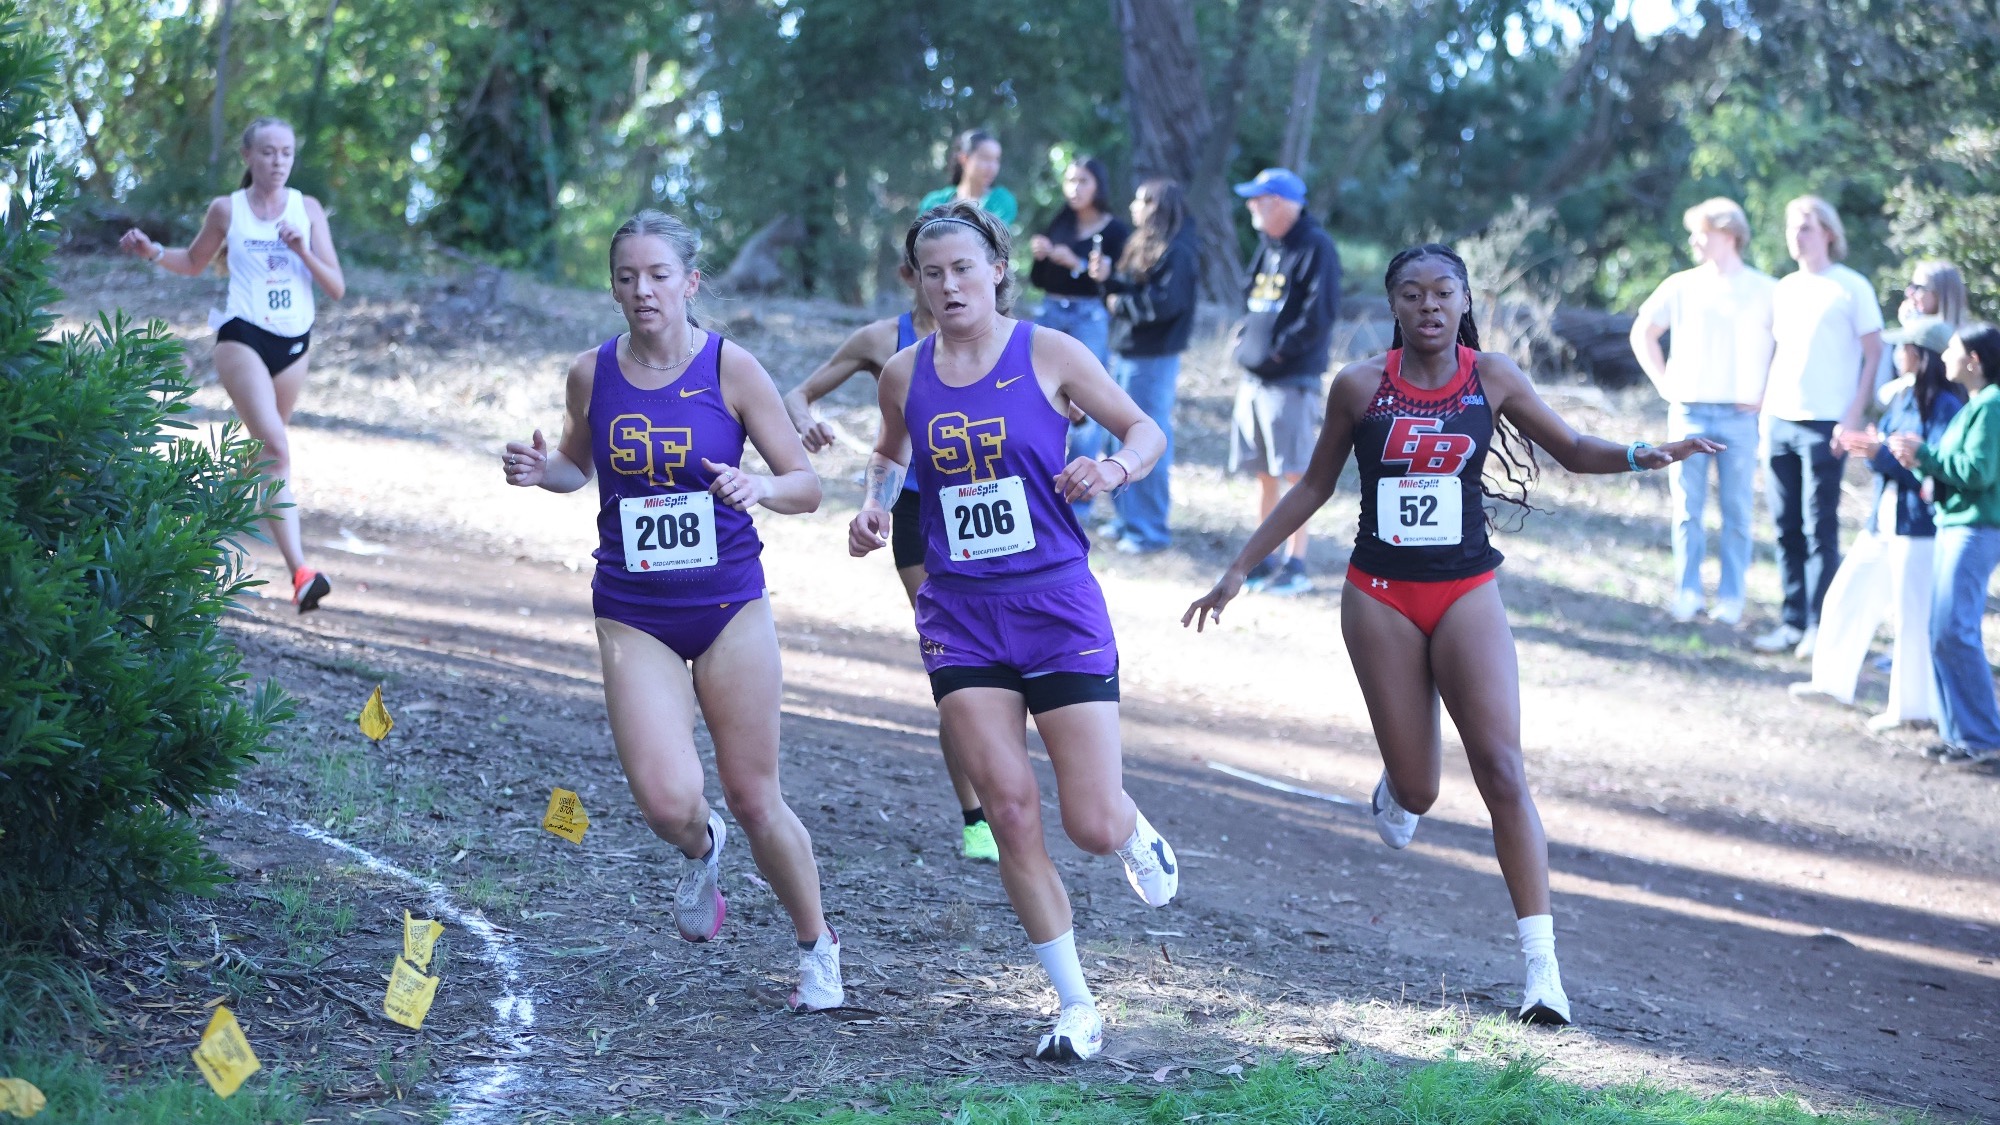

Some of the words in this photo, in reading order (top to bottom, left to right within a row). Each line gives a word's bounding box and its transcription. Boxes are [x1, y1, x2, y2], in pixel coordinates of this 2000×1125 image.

[268, 289, 291, 310] 88
[609, 413, 693, 487] SF
[928, 411, 1007, 484] SF
[1381, 416, 1477, 477] EB
[643, 495, 688, 509] MileSplit
[958, 483, 999, 498] MileSplit
[1398, 479, 1439, 490] MileSplit
[954, 499, 1015, 541] 206
[1400, 495, 1438, 527] 52
[635, 512, 701, 551] 208
